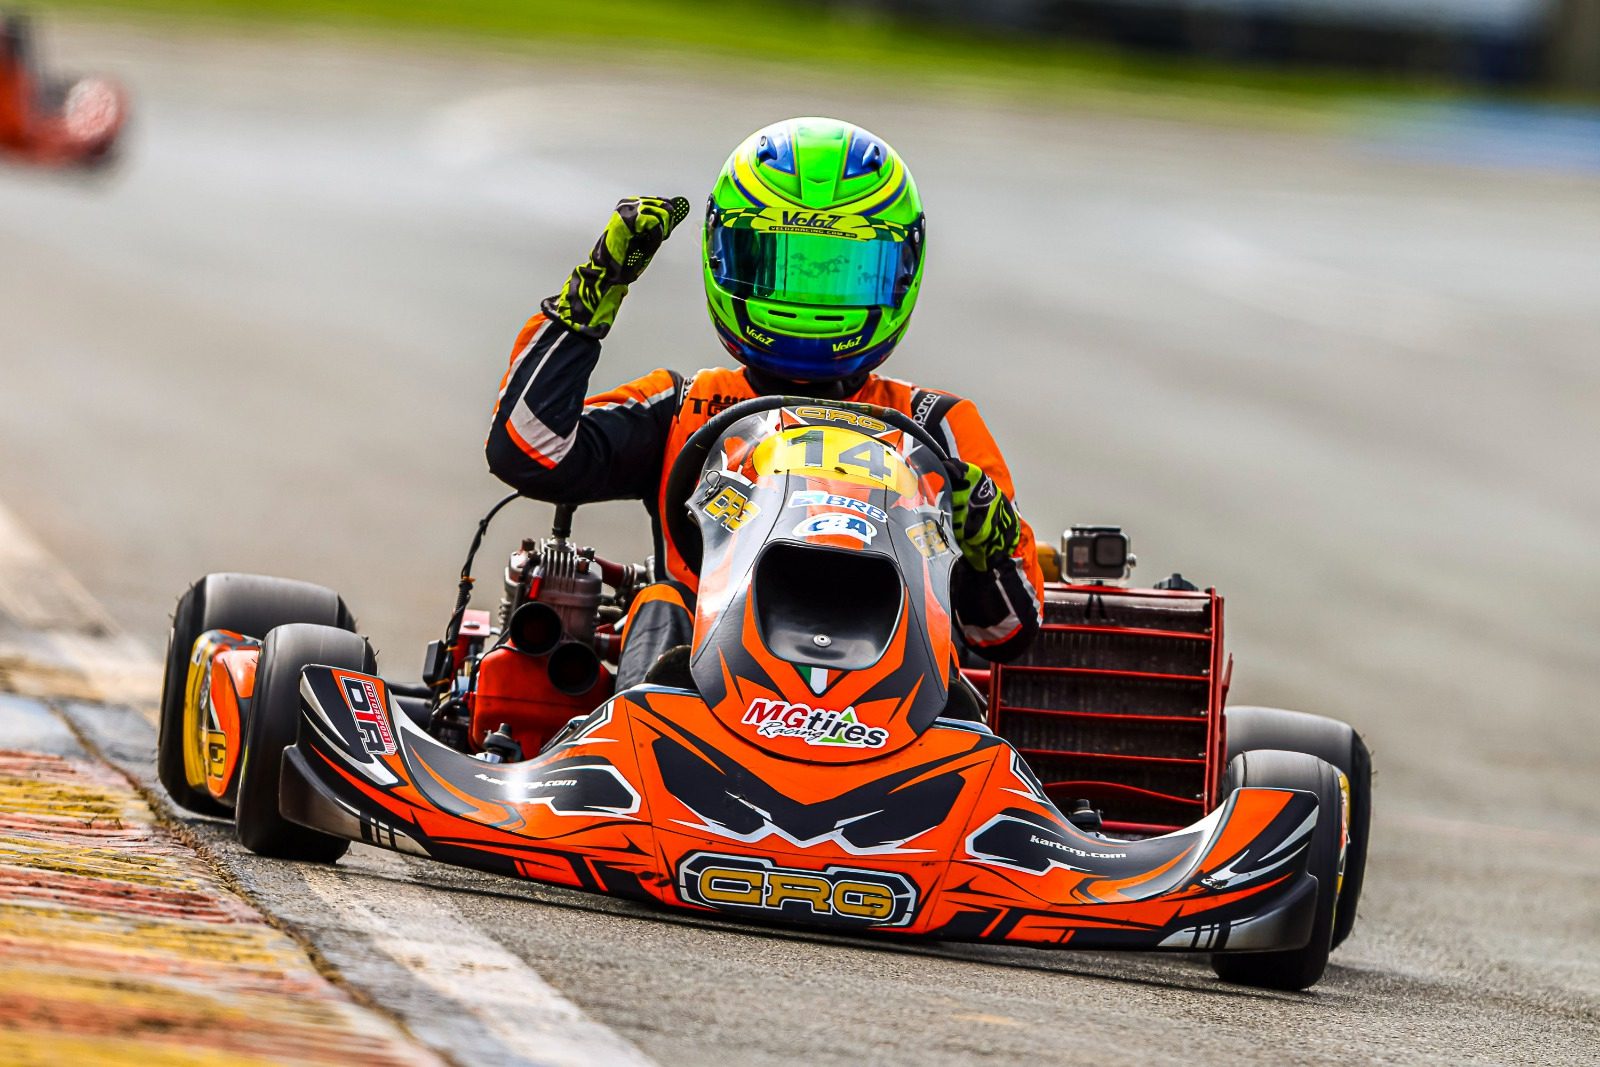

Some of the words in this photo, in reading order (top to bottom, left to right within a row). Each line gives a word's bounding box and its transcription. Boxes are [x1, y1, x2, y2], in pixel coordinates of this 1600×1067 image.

[795, 407, 888, 432] CRG
[912, 393, 938, 428] parco
[787, 430, 892, 481] 14
[825, 495, 888, 522] BRB
[807, 517, 868, 537] CA
[364, 682, 393, 743] MOTORSPORT
[744, 701, 886, 746] MGtires
[760, 721, 825, 742] Racing
[1029, 834, 1127, 859] kartcrg.com
[698, 865, 896, 922] CRG
